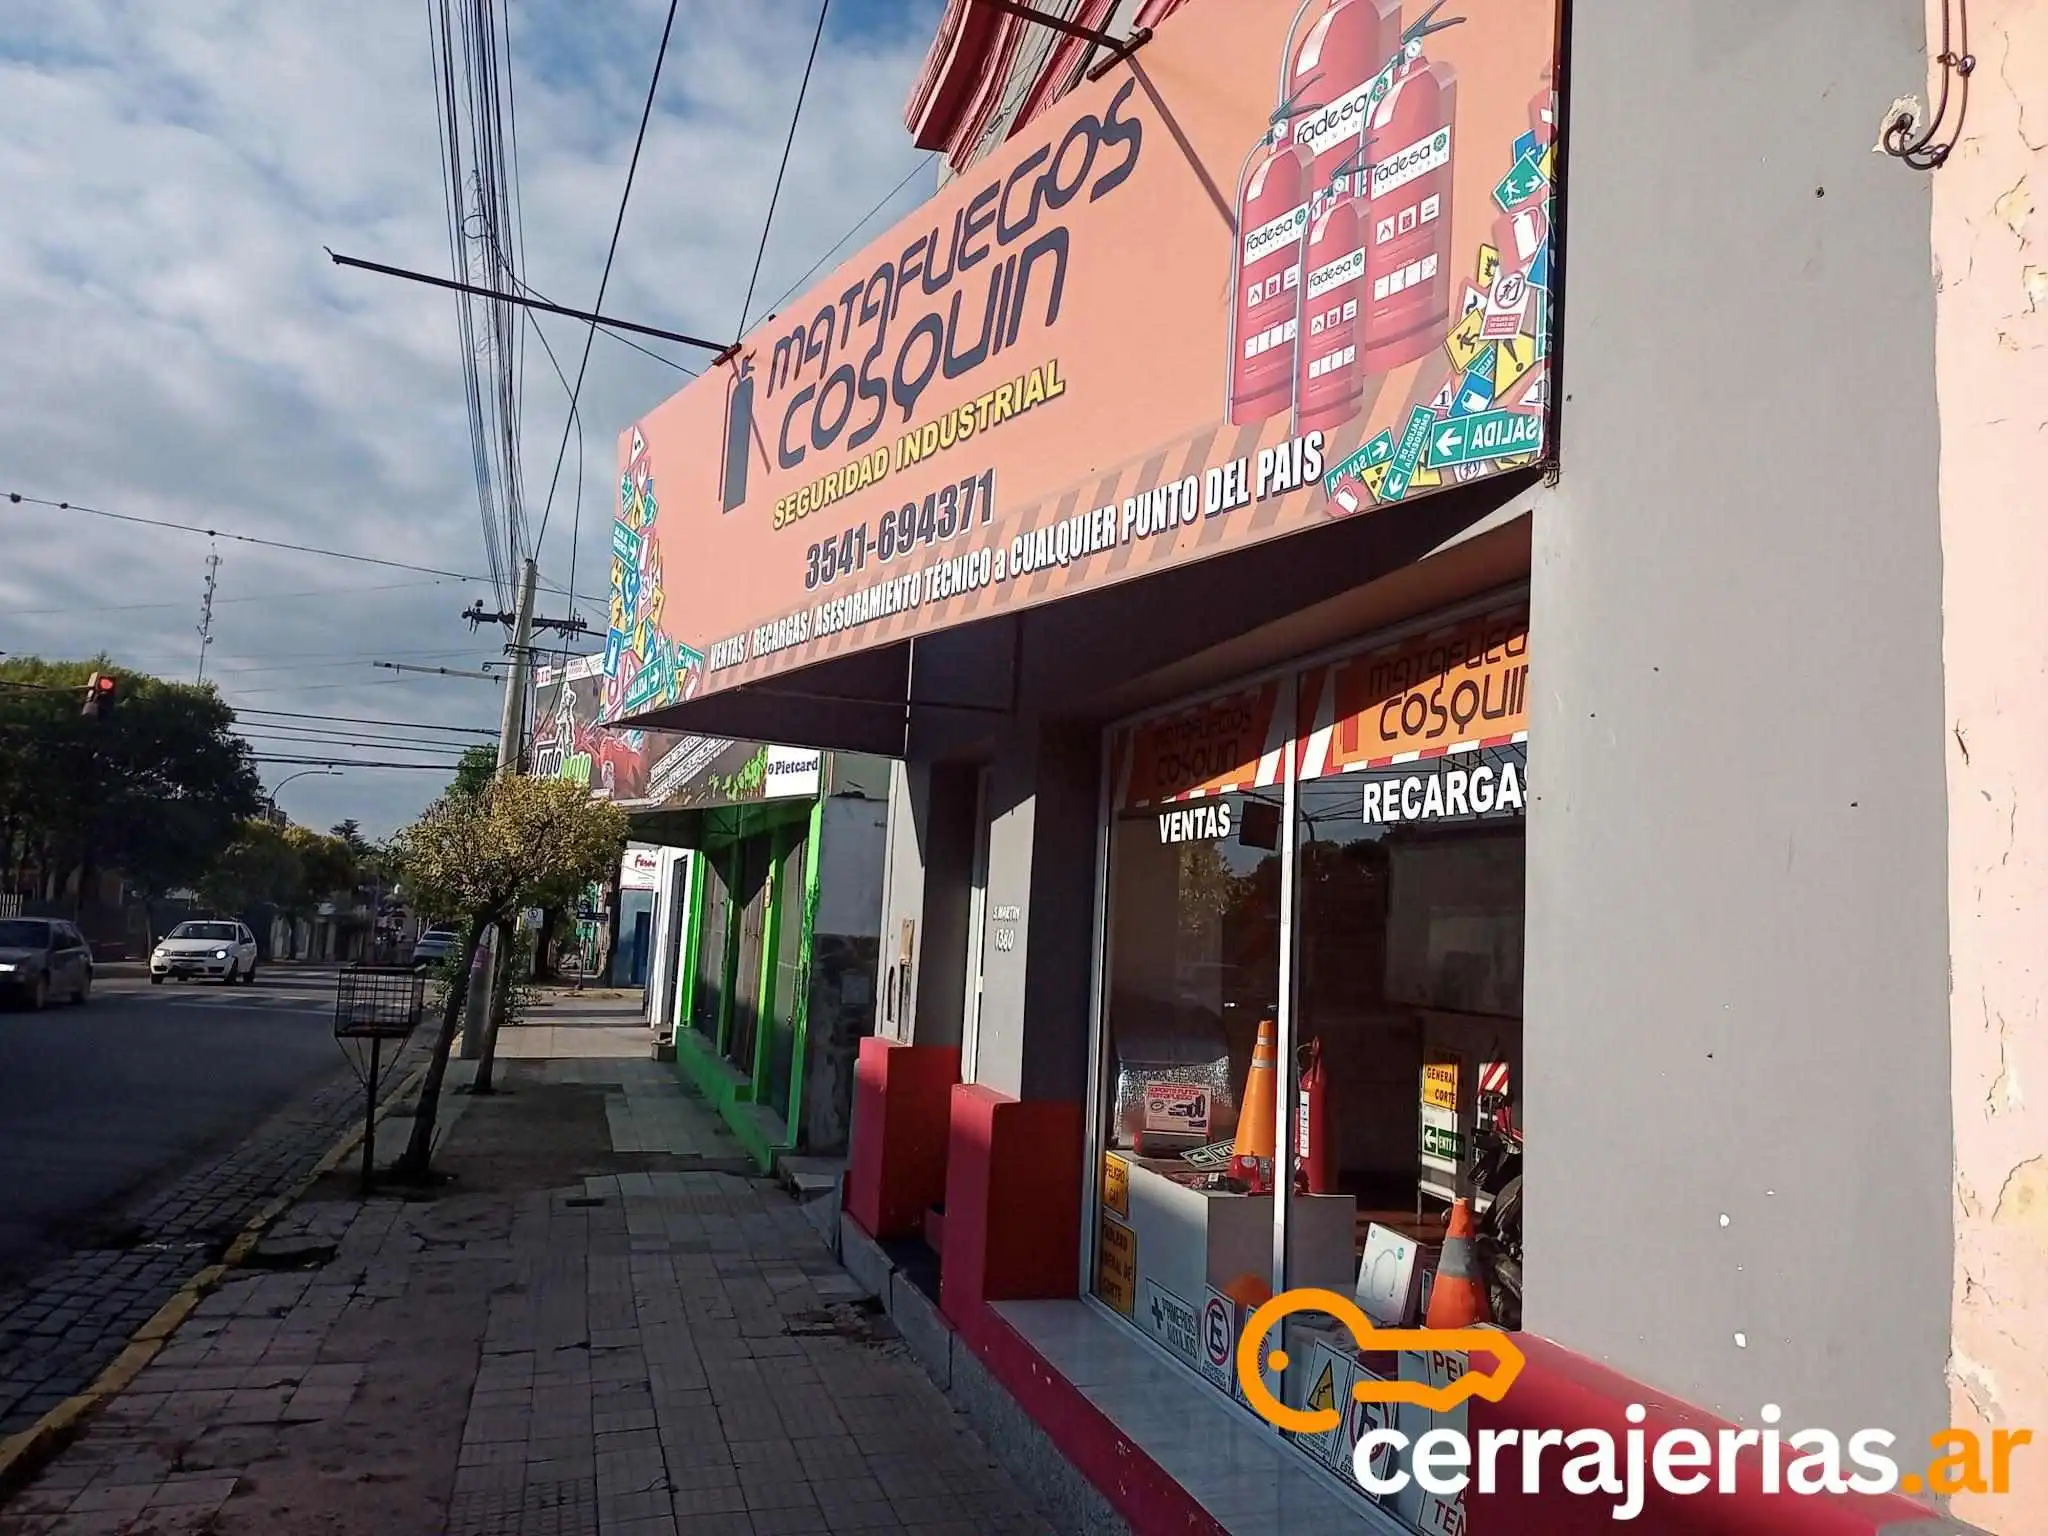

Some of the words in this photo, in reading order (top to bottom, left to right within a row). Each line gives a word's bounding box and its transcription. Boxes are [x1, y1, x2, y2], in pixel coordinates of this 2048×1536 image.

[1297, 94, 1369, 144] fadesa
[1374, 145, 1431, 185] fadesa
[767, 76, 1143, 399] MATAFUEGOS
[1246, 217, 1293, 252] fadesa
[778, 226, 1070, 470] COSQUIN
[773, 445, 890, 532] SEGURIDAD
[895, 358, 1066, 474] INDUSTRIAL
[711, 634, 746, 672] VENTAS
[924, 546, 993, 602] TÉCNICO
[994, 548, 1006, 583] a
[1010, 504, 1118, 578] CUALQUIER
[1121, 475, 1200, 545] PUNTO
[1204, 456, 1251, 518] DEL
[805, 467, 996, 590] 3541-694371
[776, 757, 818, 776] Pietcard
[1159, 803, 1231, 843] VENTAS
